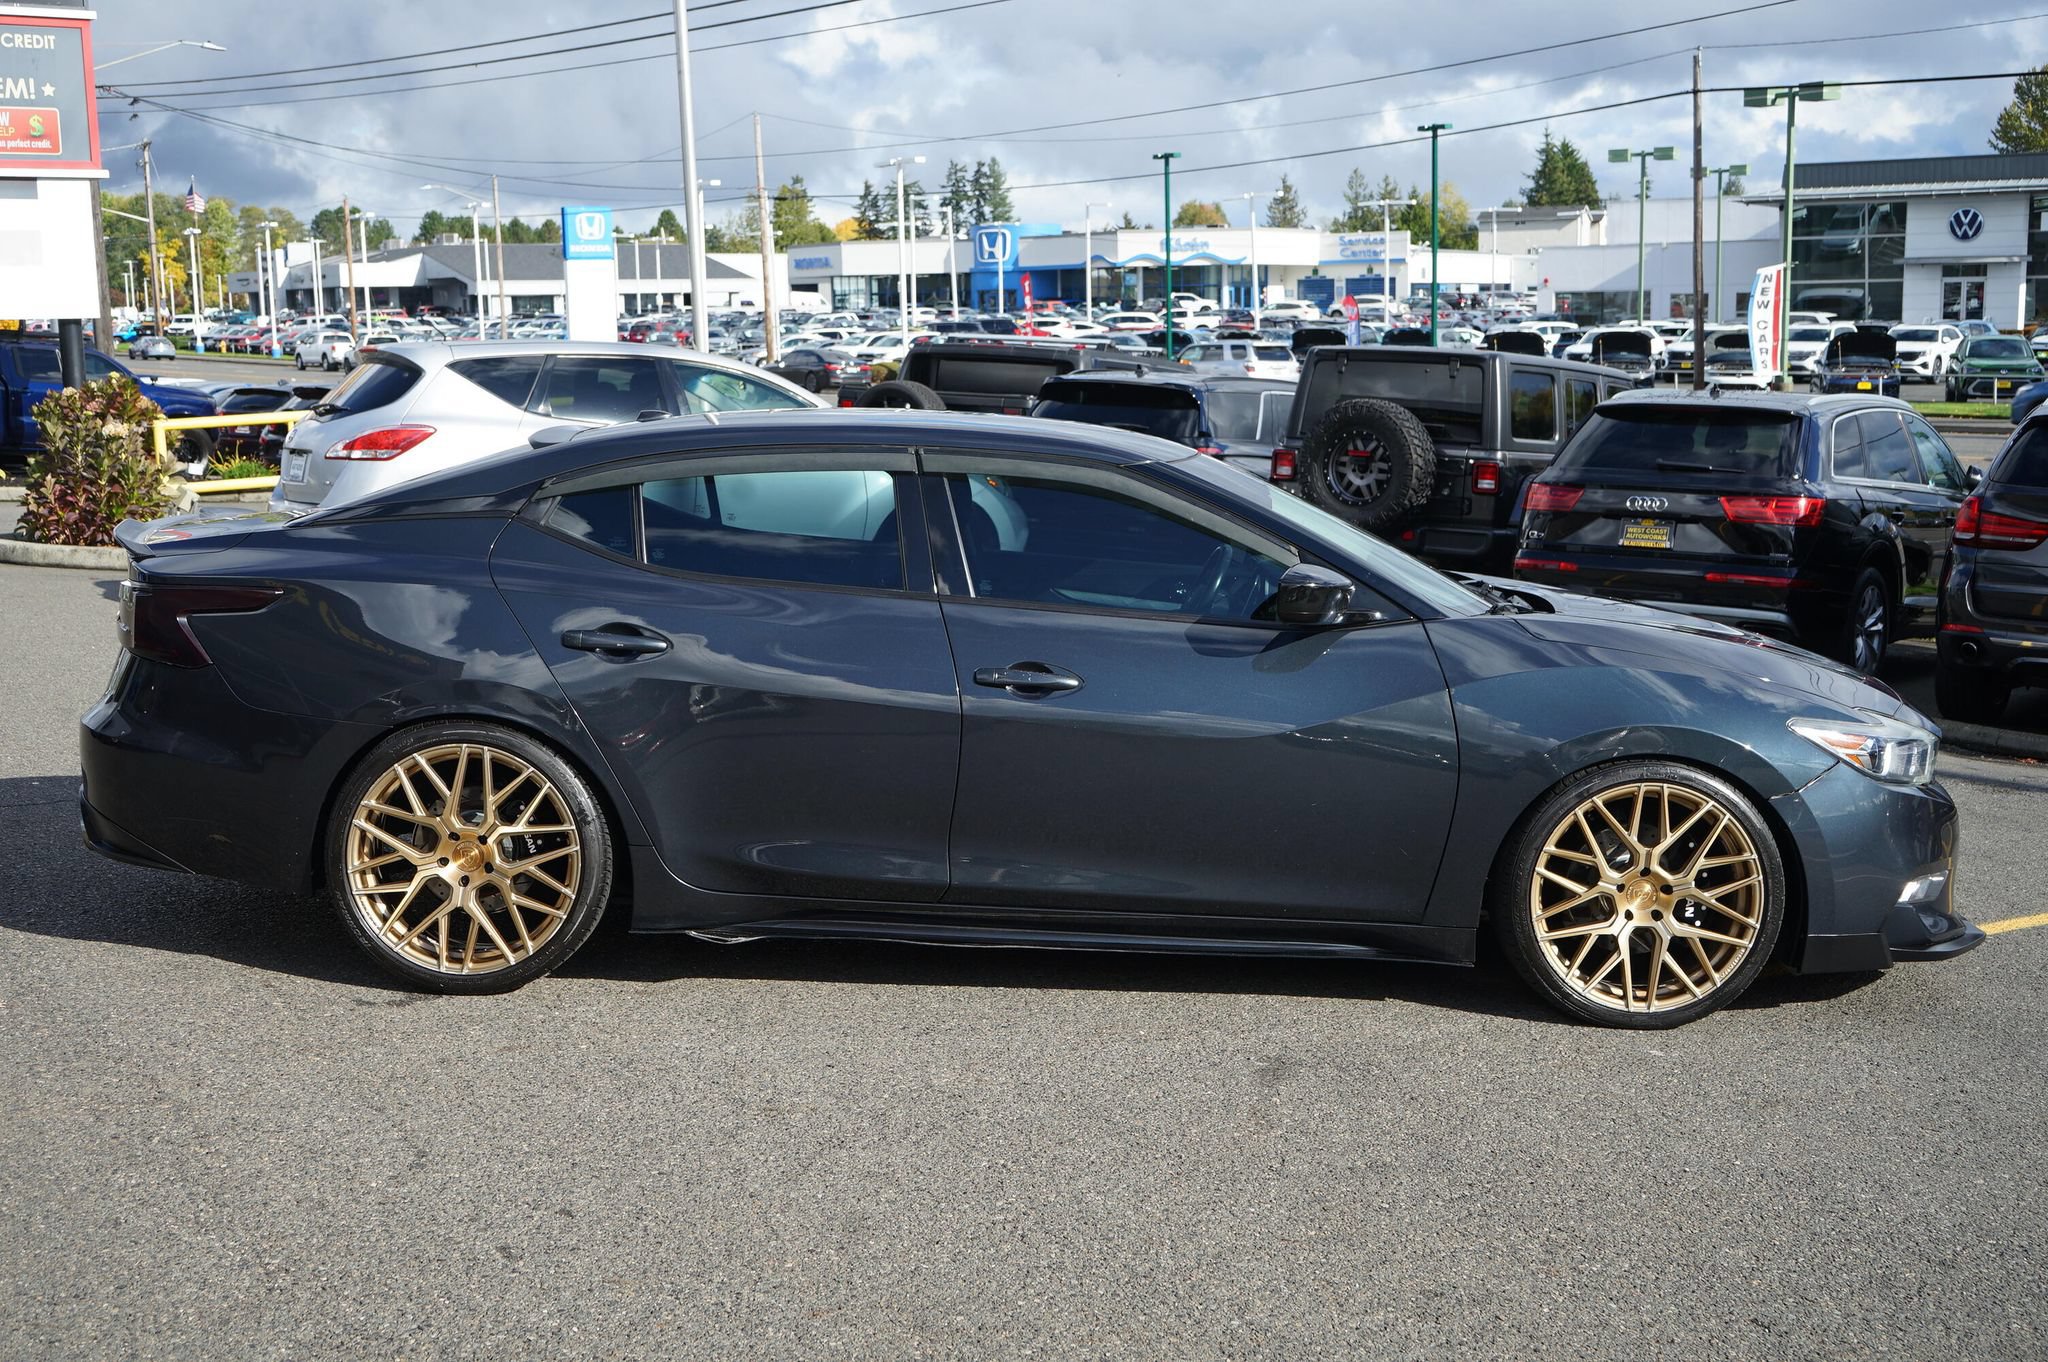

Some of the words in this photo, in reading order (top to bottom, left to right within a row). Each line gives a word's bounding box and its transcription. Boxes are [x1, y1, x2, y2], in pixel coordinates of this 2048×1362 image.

[1, 33, 56, 49] CREDIT
[1756, 273, 1773, 310] NEW
[1756, 320, 1768, 369] CARS
[1626, 533, 1666, 541] AUTOWORKS
